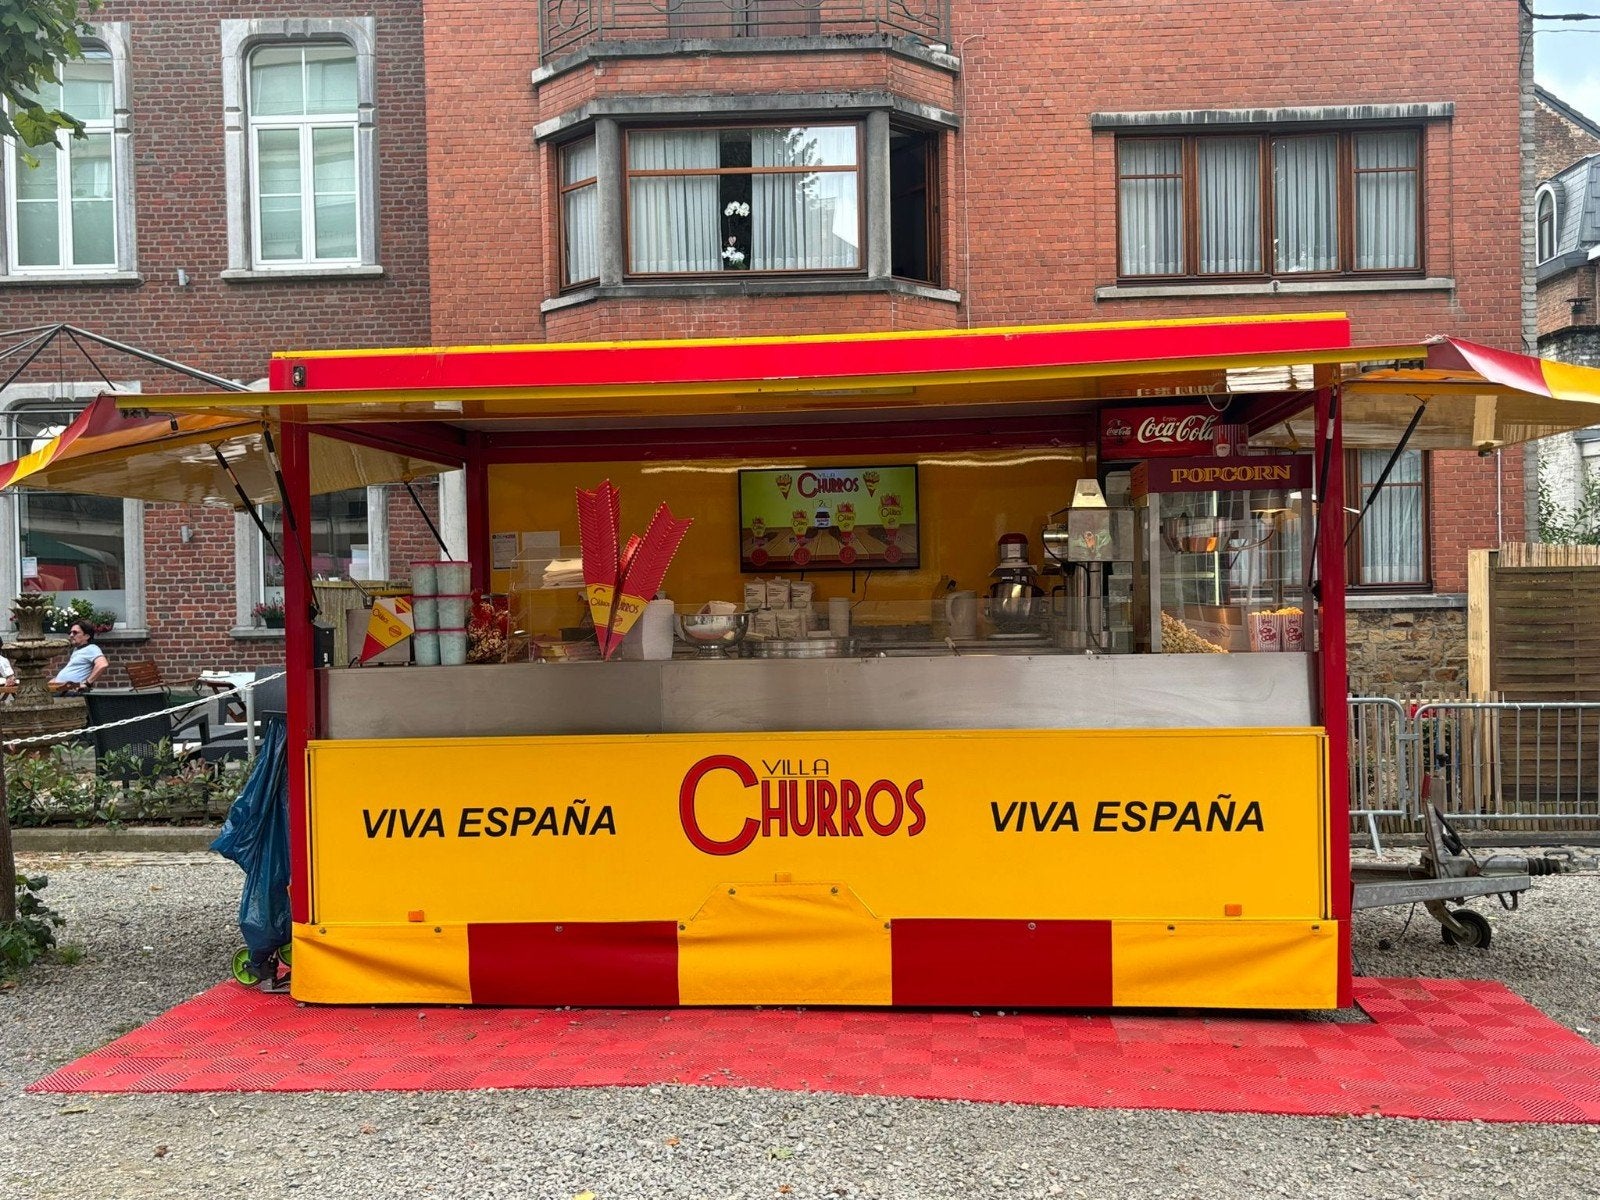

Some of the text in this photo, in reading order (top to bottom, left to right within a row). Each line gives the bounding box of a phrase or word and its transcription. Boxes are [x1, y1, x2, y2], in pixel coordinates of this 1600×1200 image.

[1137, 415, 1219, 444] Coca-Cola
[797, 471, 860, 499] CHURROS
[1170, 465, 1292, 484] POPCORN
[763, 758, 830, 775] VILLA
[363, 799, 617, 839] VIVA ESPAÑA
[679, 754, 926, 855] CHURROS
[991, 793, 1265, 833] VIVA ESPAÑA
